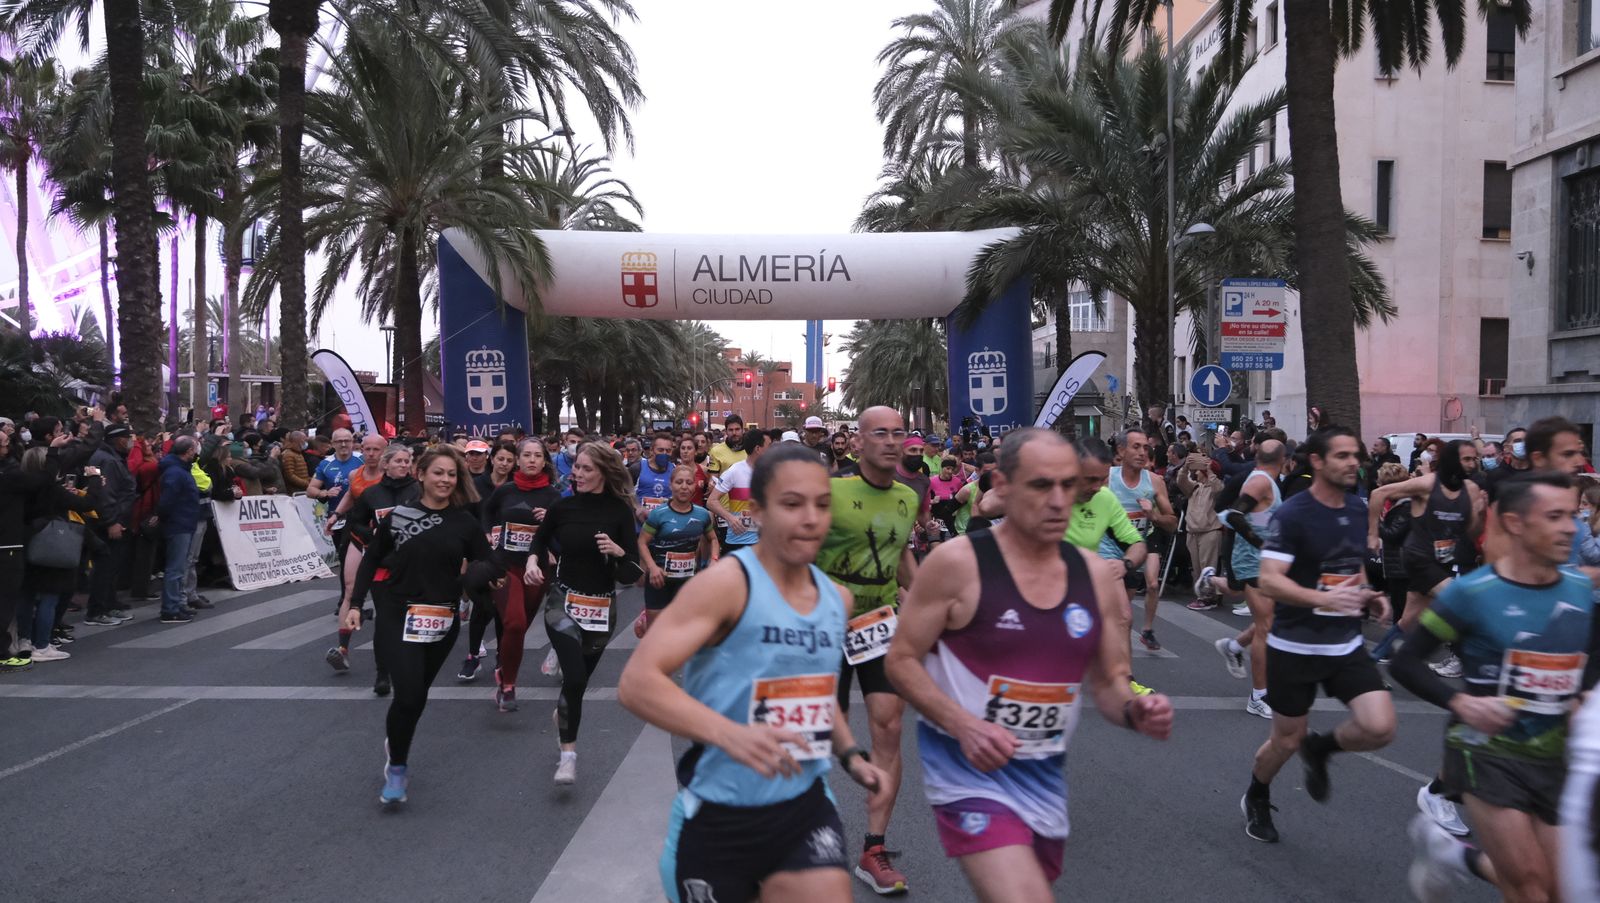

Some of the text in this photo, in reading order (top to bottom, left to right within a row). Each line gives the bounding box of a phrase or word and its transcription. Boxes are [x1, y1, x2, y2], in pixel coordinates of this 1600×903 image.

[1195, 27, 1220, 60] PALAC
[692, 248, 852, 282] ALMERÍA
[692, 288, 773, 305] CIUDAD
[239, 499, 281, 520] AMSA
[392, 513, 444, 551] didas
[235, 560, 267, 573] Transportes
[671, 560, 691, 569] 3381
[238, 572, 267, 584] ANTONIO
[414, 617, 446, 629] 3361
[572, 606, 603, 618] 3374
[761, 624, 832, 654] nerja
[854, 623, 890, 649] 479
[770, 703, 832, 728] 3473
[1003, 703, 1059, 729] 328
